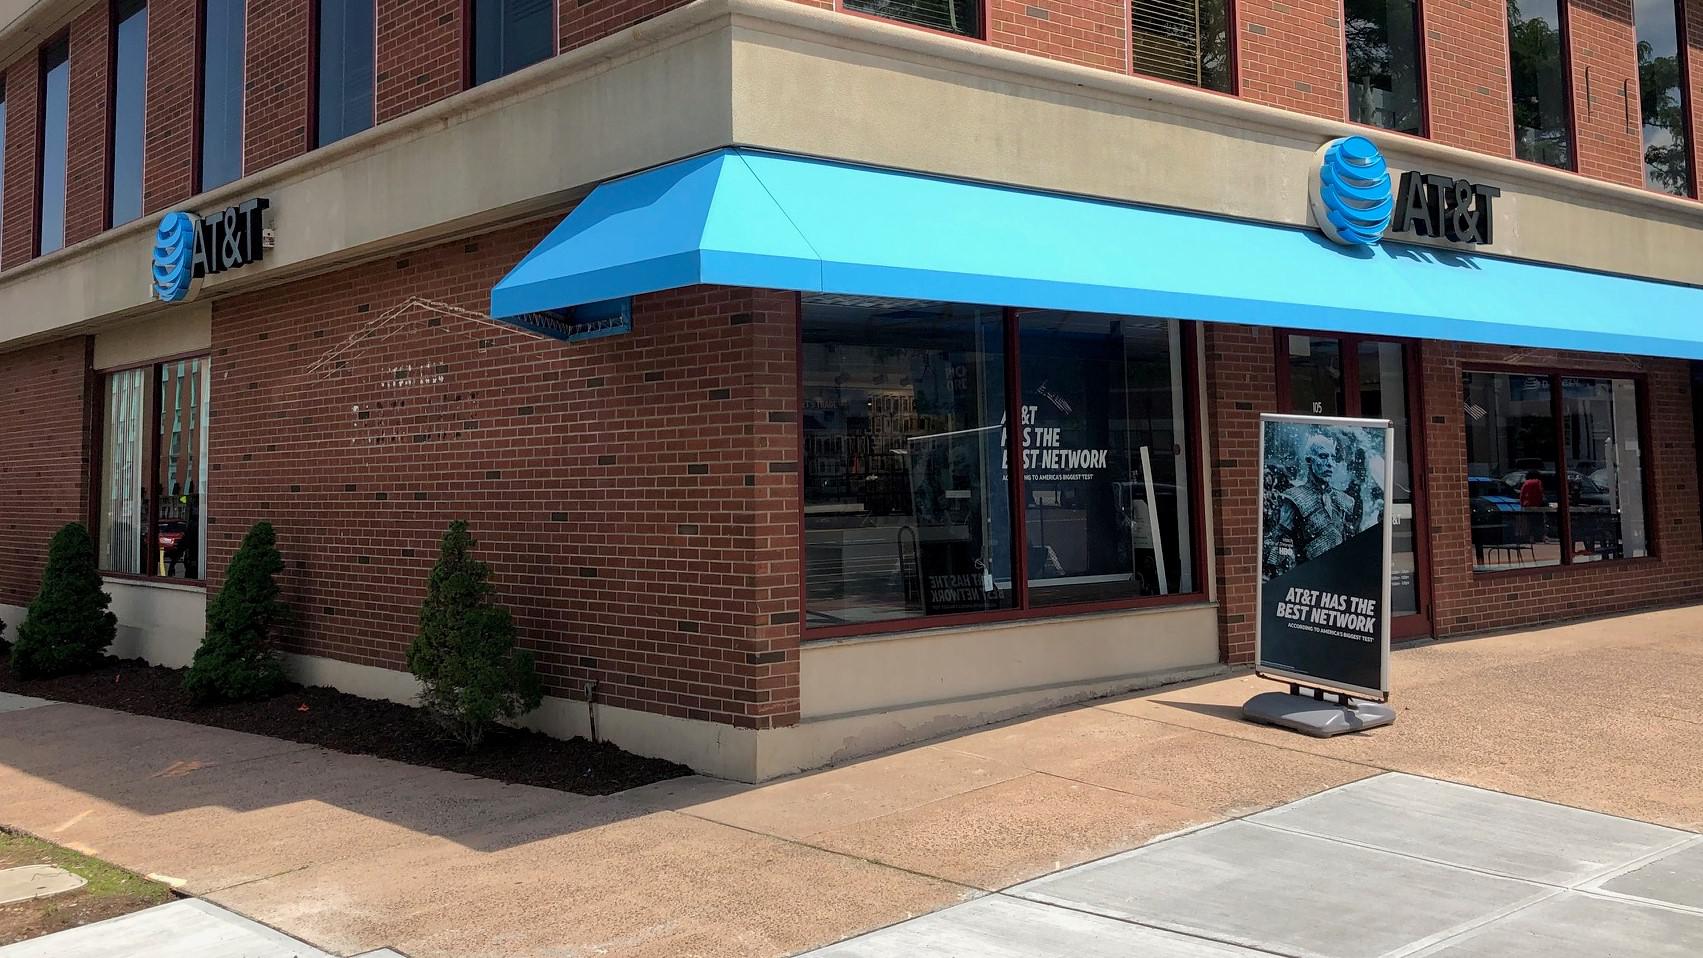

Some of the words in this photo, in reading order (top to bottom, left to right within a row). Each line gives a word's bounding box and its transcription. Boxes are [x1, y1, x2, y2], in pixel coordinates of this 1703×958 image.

[1393, 171, 1500, 244] AT&T
[191, 198, 269, 278] AT&T
[1000, 405, 1038, 424] &T
[1312, 401, 1323, 413] 105
[1035, 428, 1060, 447] THE
[1002, 450, 1039, 469] ST
[1042, 450, 1108, 469] NETWORK
[1286, 587, 1320, 605] AT&T
[1321, 592, 1347, 610] HAS
[1350, 597, 1376, 615] THE
[1276, 602, 1309, 621] BEST
[1310, 607, 1376, 633] NETWORK
[1288, 622, 1313, 632] ACCORDING
[1344, 632, 1362, 640] BIGGEST
